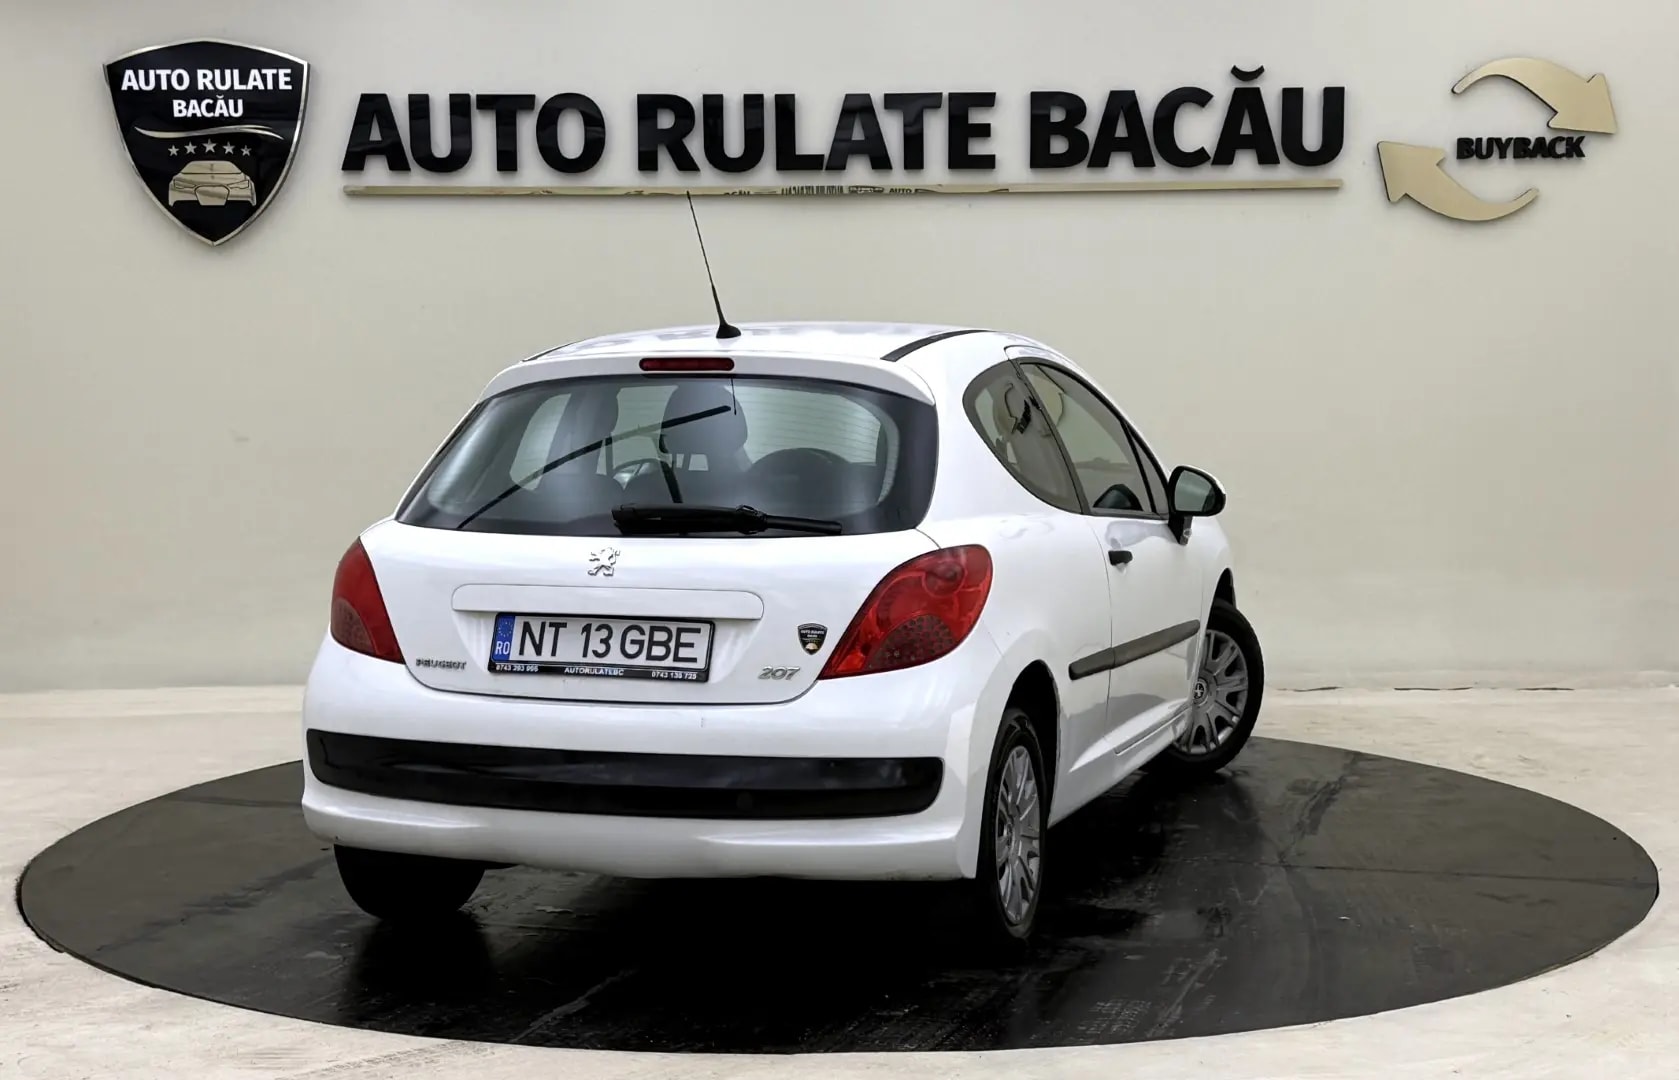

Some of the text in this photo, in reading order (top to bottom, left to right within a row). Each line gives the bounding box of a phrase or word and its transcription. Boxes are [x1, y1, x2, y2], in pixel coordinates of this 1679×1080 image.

[121, 69, 292, 91] AUTO RULATE
[172, 94, 244, 118] BACĂU
[341, 65, 1345, 173] AUTO RULATE BACĂU
[1456, 136, 1585, 159] BUYBACK
[495, 640, 510, 655] RO
[519, 621, 701, 663] NT 13 GBE
[758, 666, 801, 681] 207
